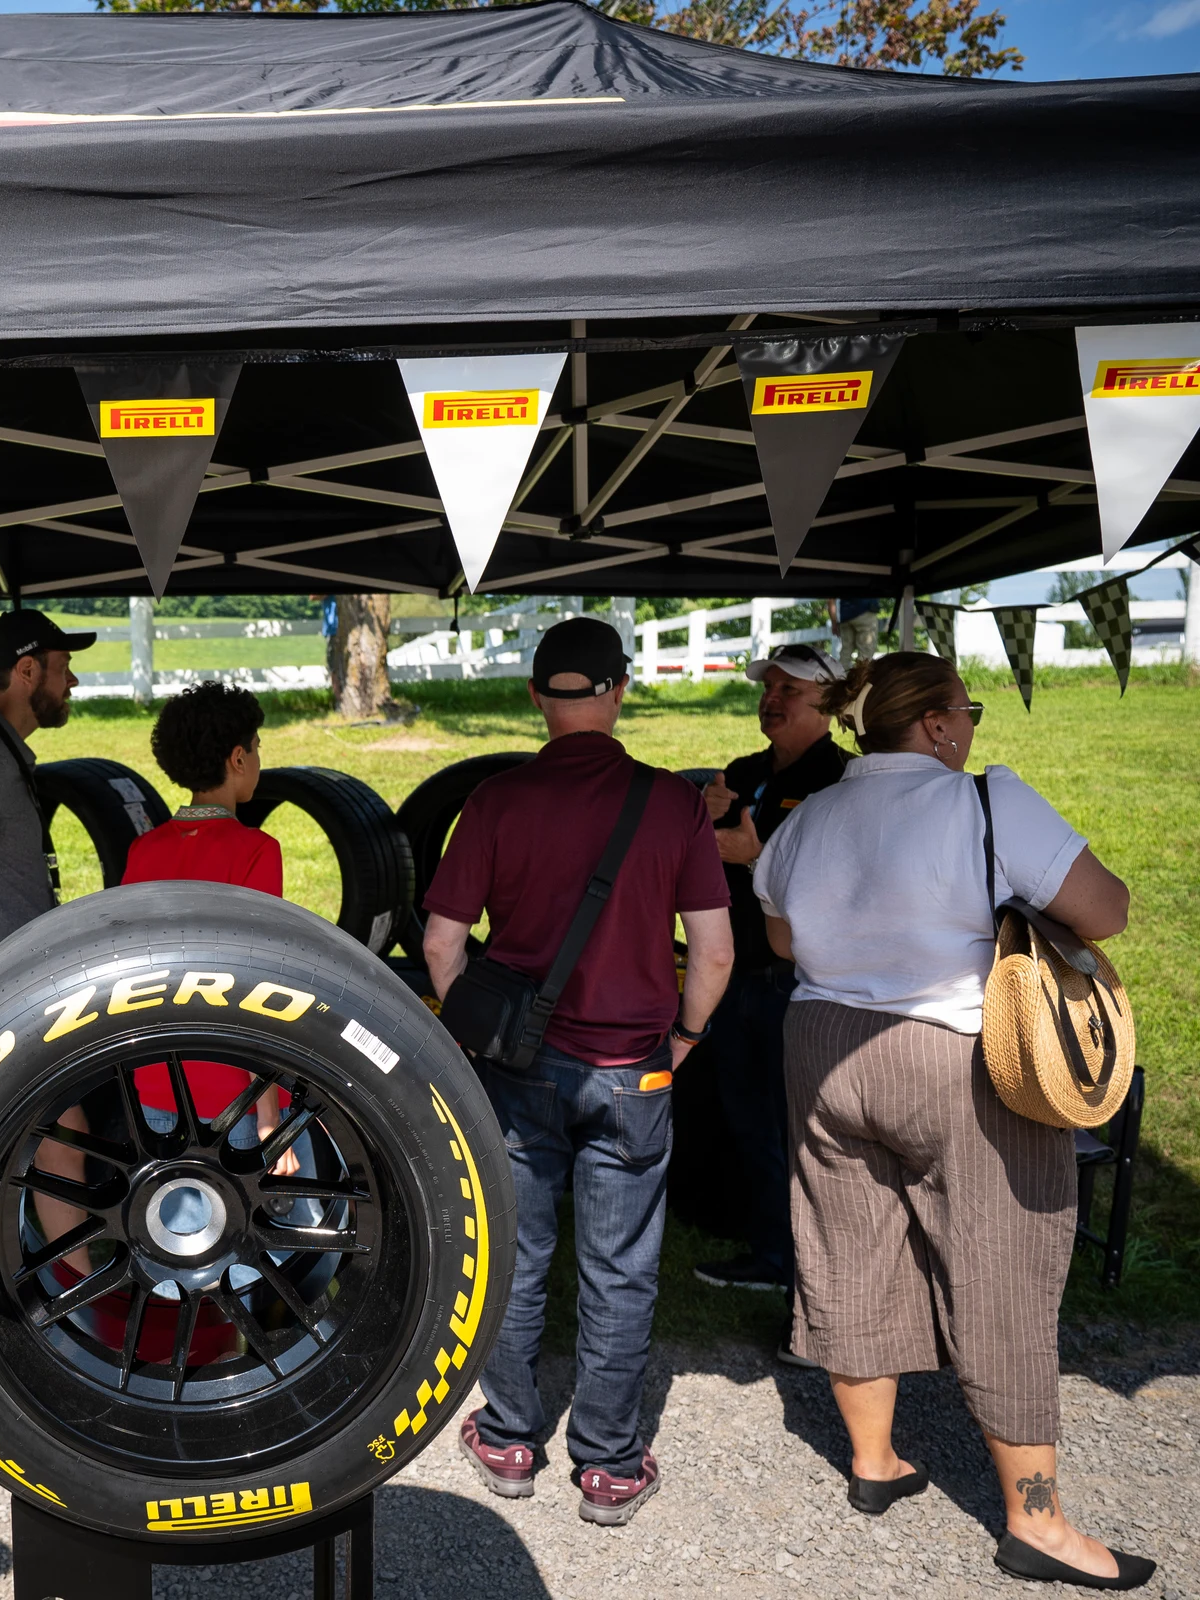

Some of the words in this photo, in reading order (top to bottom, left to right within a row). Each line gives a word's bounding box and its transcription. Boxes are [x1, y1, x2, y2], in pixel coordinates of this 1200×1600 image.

[1103, 364, 1200, 391] PIRELL
[763, 379, 862, 407] PIRELLI
[110, 406, 205, 430] PIRELLI
[433, 397, 529, 421] PIRELLI
[43, 969, 316, 1043] ZERO
[442, 1208, 452, 1243] PIRELLI
[367, 1434, 386, 1452] FSC
[146, 1482, 313, 1532] PIRELLI
